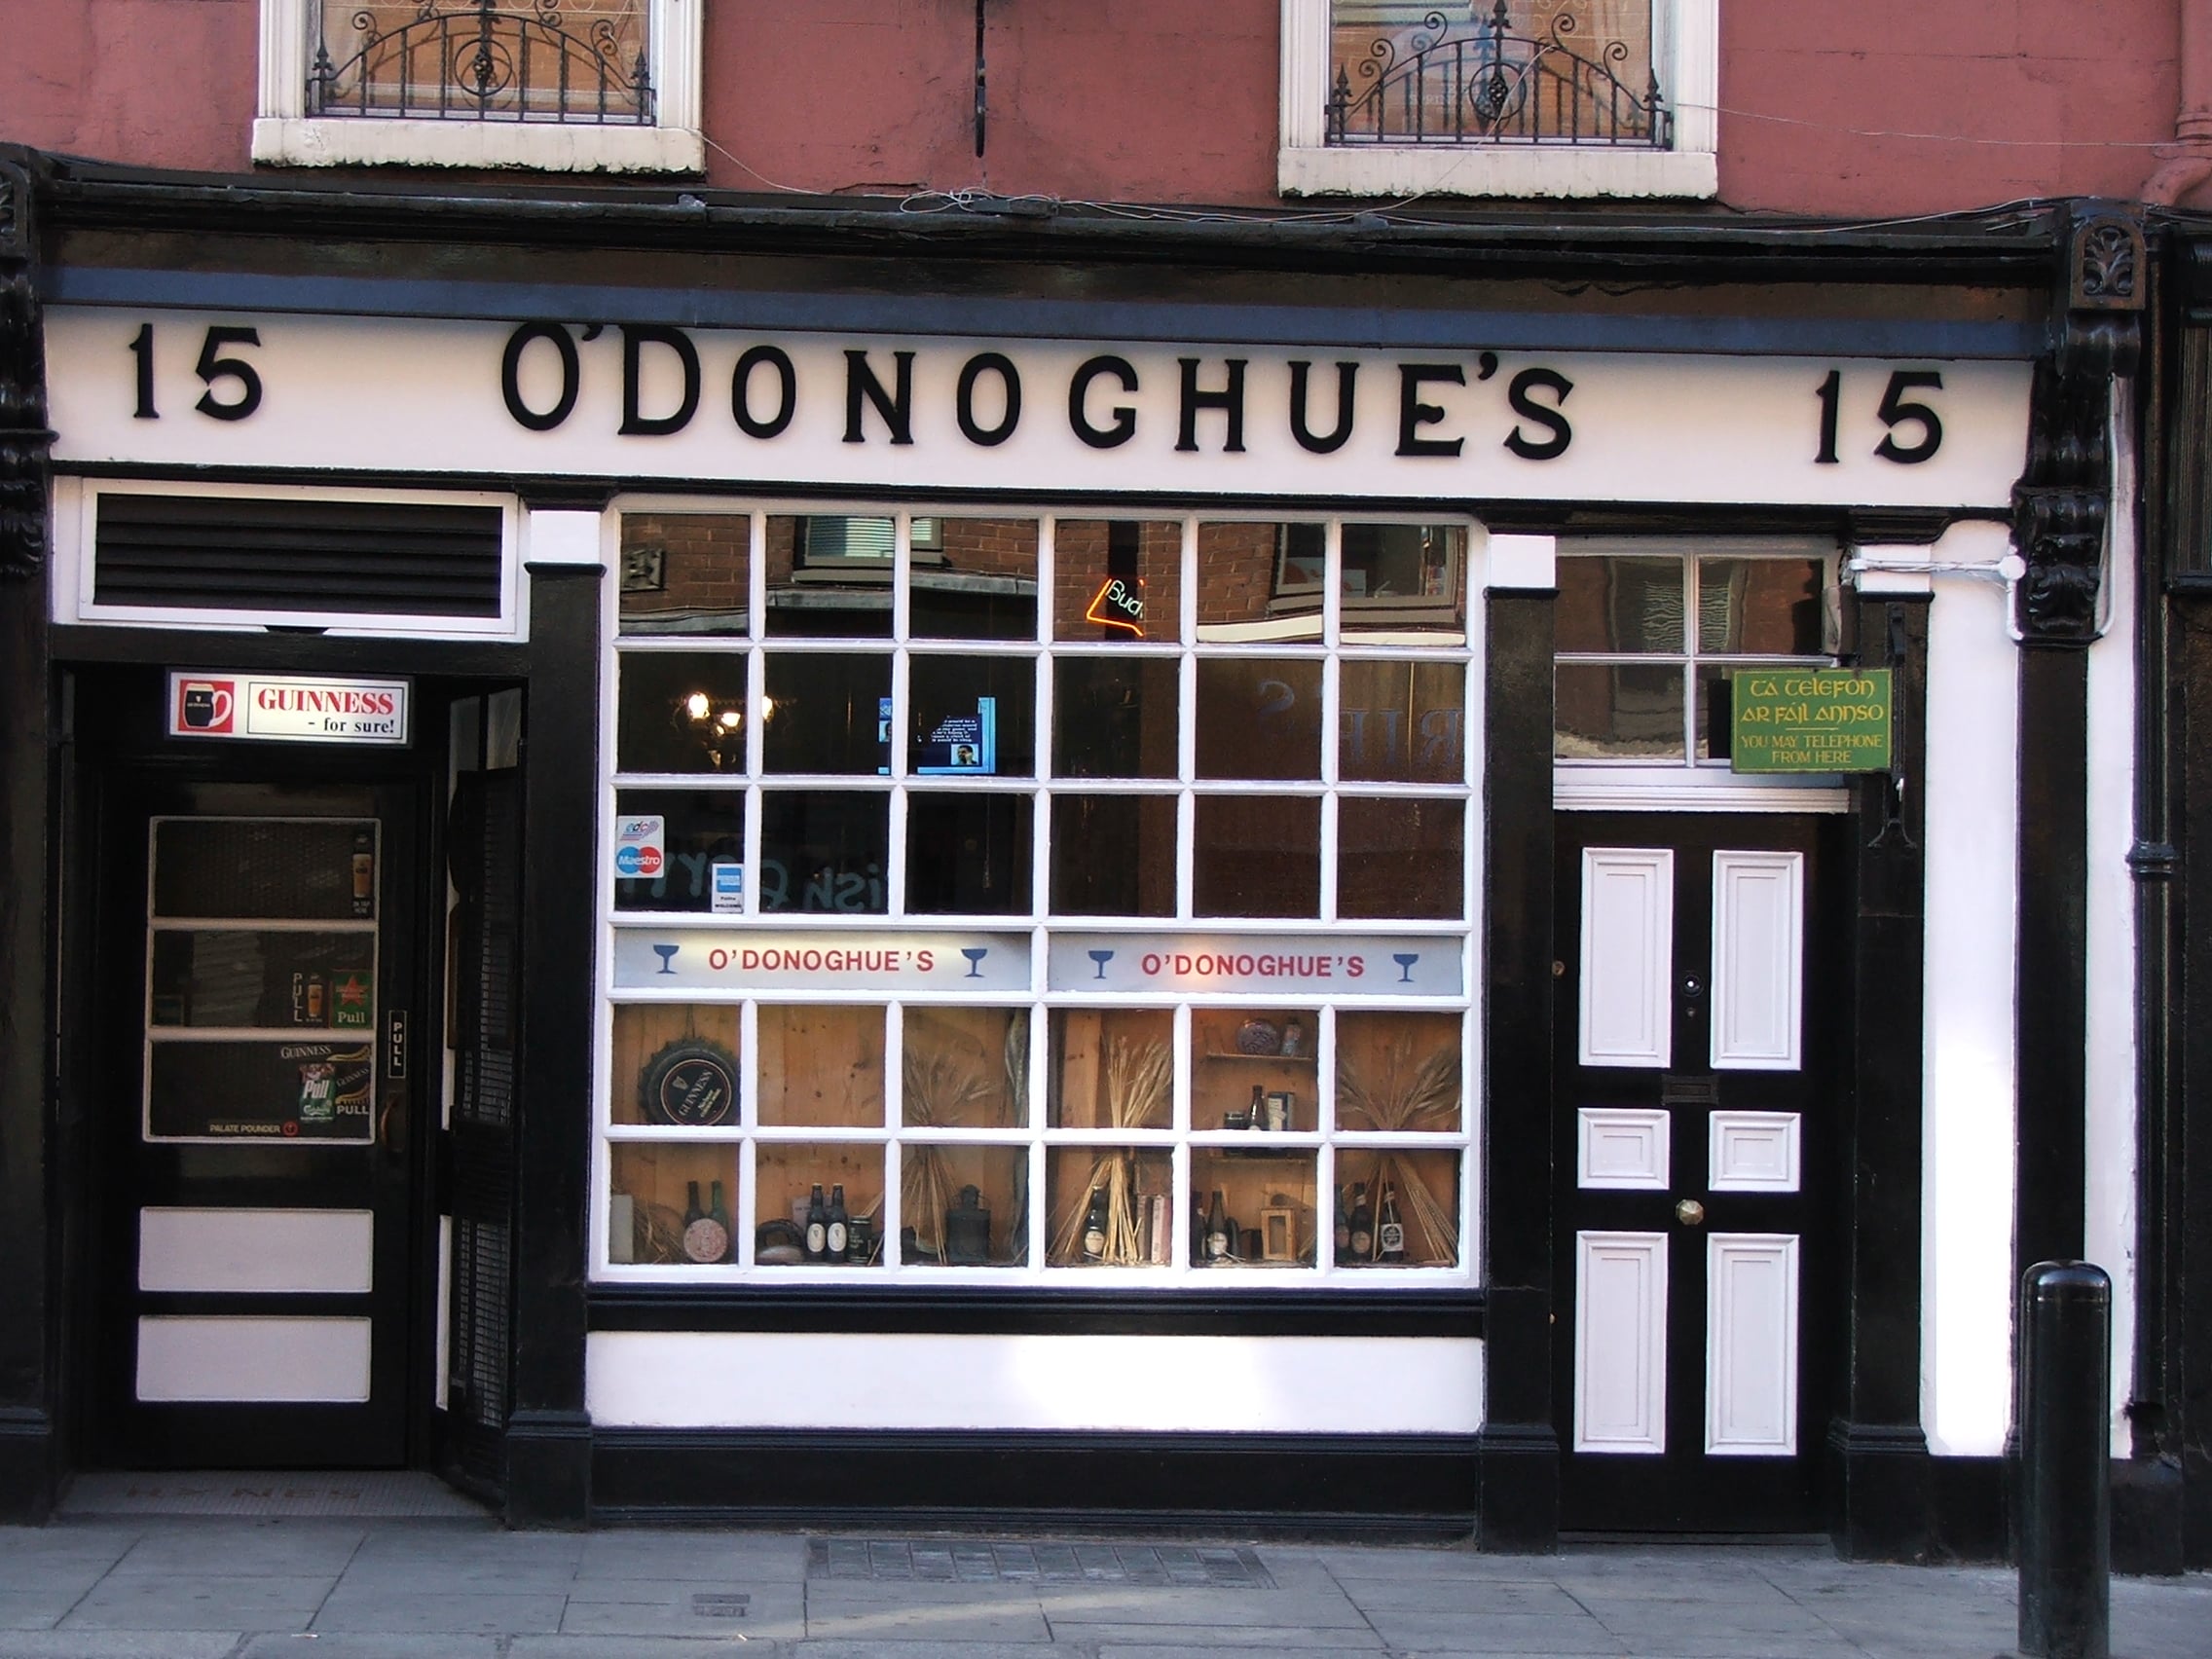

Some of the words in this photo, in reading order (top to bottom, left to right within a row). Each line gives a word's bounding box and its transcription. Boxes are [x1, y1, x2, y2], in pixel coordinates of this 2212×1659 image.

[129, 322, 263, 422] 15
[500, 321, 1574, 461] O'DONOGHUE'S
[1814, 369, 1944, 464] 15
[1105, 579, 1143, 615] Bud
[258, 688, 394, 715] GUINNESS
[323, 718, 347, 731] for
[353, 719, 394, 733] sure!
[1741, 735, 1768, 749] YOU
[1771, 736, 1799, 748] MAY
[1805, 734, 1883, 749] TELEPHONE
[1771, 750, 1811, 764] FROM
[1815, 750, 1853, 764] HERE
[618, 855, 661, 866] Maestro
[708, 948, 935, 972] O'DONOGHUE'S
[1141, 953, 1365, 977] O'DONOGHUE'S
[292, 973, 304, 1022] PULL
[337, 1012, 366, 1023] Pull
[280, 1045, 332, 1059] GUINNESS
[392, 1021, 403, 1067] PULL
[303, 1079, 330, 1099] Pull
[678, 1069, 714, 1116] GUINNESS
[336, 1105, 369, 1115] PULL
